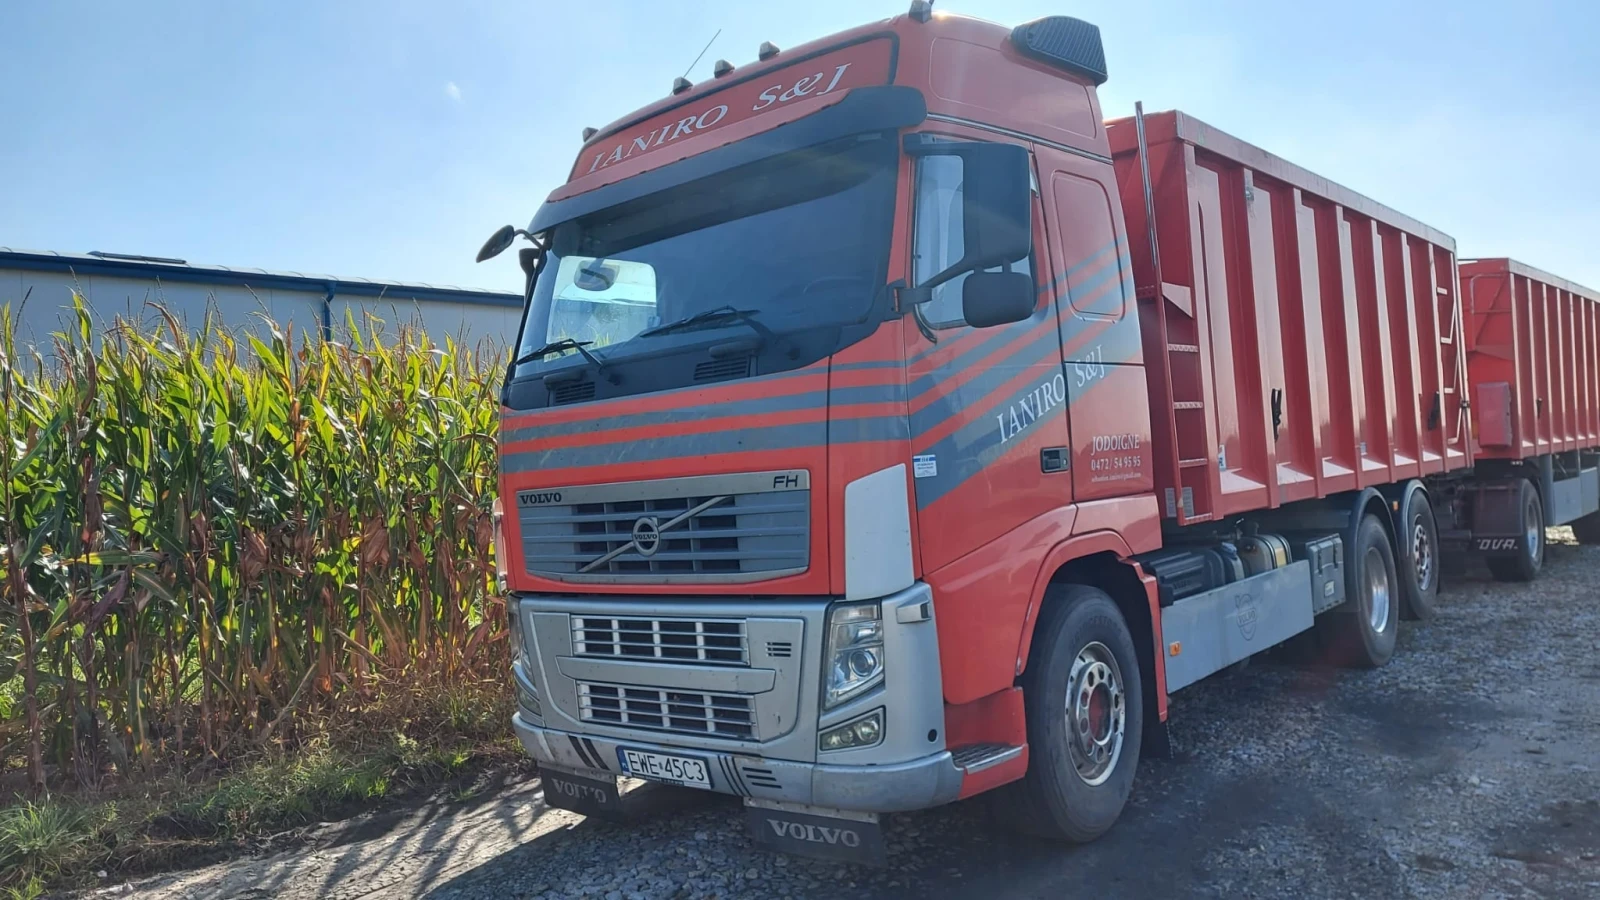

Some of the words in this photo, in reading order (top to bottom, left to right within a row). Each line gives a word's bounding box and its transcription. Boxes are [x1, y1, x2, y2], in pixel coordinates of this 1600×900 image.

[586, 104, 729, 175] IANIRO
[752, 62, 852, 111] S&J
[996, 373, 1066, 444] IANIRO
[1074, 344, 1105, 388] S&J
[1090, 434, 1140, 456] JODOIGNE
[773, 474, 799, 489] FH
[519, 492, 562, 505] VOLVO
[766, 818, 861, 848] VOLVO
